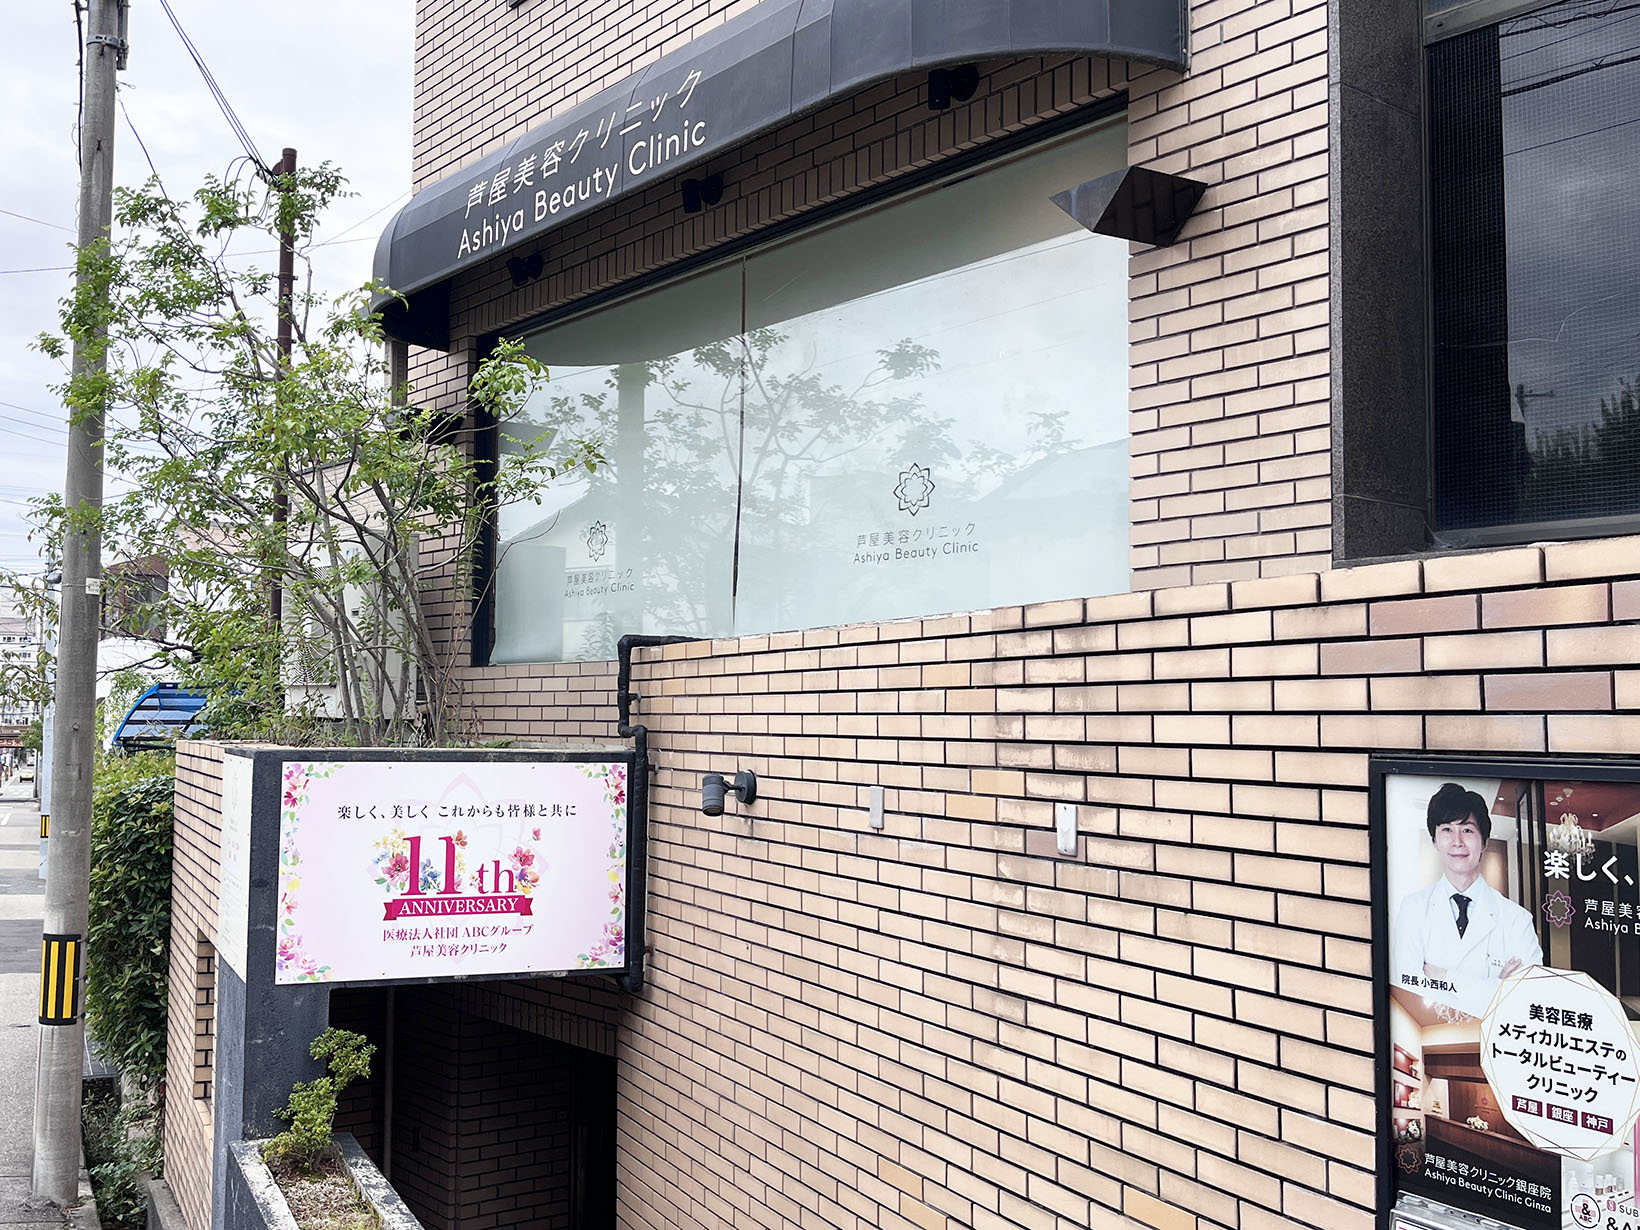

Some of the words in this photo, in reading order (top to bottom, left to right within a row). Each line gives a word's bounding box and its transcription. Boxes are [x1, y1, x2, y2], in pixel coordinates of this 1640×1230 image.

[465, 69, 702, 219] 芦屋美容クリニック
[457, 209, 524, 258] Ashiya
[534, 163, 618, 222] Beauty
[628, 119, 706, 175] Clinic
[856, 521, 976, 548] 芦屋美容クリニック
[853, 551, 890, 565] Ashiya
[895, 546, 938, 559] Beauty
[942, 541, 979, 555] Clinic
[564, 589, 585, 599] Ashiya
[586, 585, 608, 596] Beauty
[610, 582, 635, 593] Clinic
[337, 805, 429, 820] 楽しく、美しく
[438, 804, 577, 818] これからも皆様と共に
[1543, 850, 1635, 886] 楽しく、
[399, 898, 519, 916] ANNIVERSARY
[383, 926, 458, 942] 医療法人社団
[462, 923, 534, 938] ABCグループ
[1584, 916, 1629, 936] Ashiya
[410, 942, 508, 958] 芦屋美容クリニック
[1401, 973, 1420, 987] 院長
[1420, 977, 1458, 993] 小西和人
[1528, 1003, 1593, 1031] 美容医療
[1498, 1022, 1628, 1062] メディカルエステの
[1492, 1042, 1636, 1086] トータルビューティー
[1526, 1073, 1599, 1103] クリニック
[1516, 1097, 1540, 1115] 芦屋
[1551, 1106, 1575, 1124] 銀座
[1585, 1114, 1610, 1131] 神戸
[1424, 1152, 1552, 1201] 芦屋美容クリニック銀座院
[1424, 1168, 1456, 1185] Ashiya
[1458, 1176, 1493, 1198] Beauty
[1494, 1187, 1523, 1205] Clinic
[1524, 1196, 1552, 1214] Ginza
